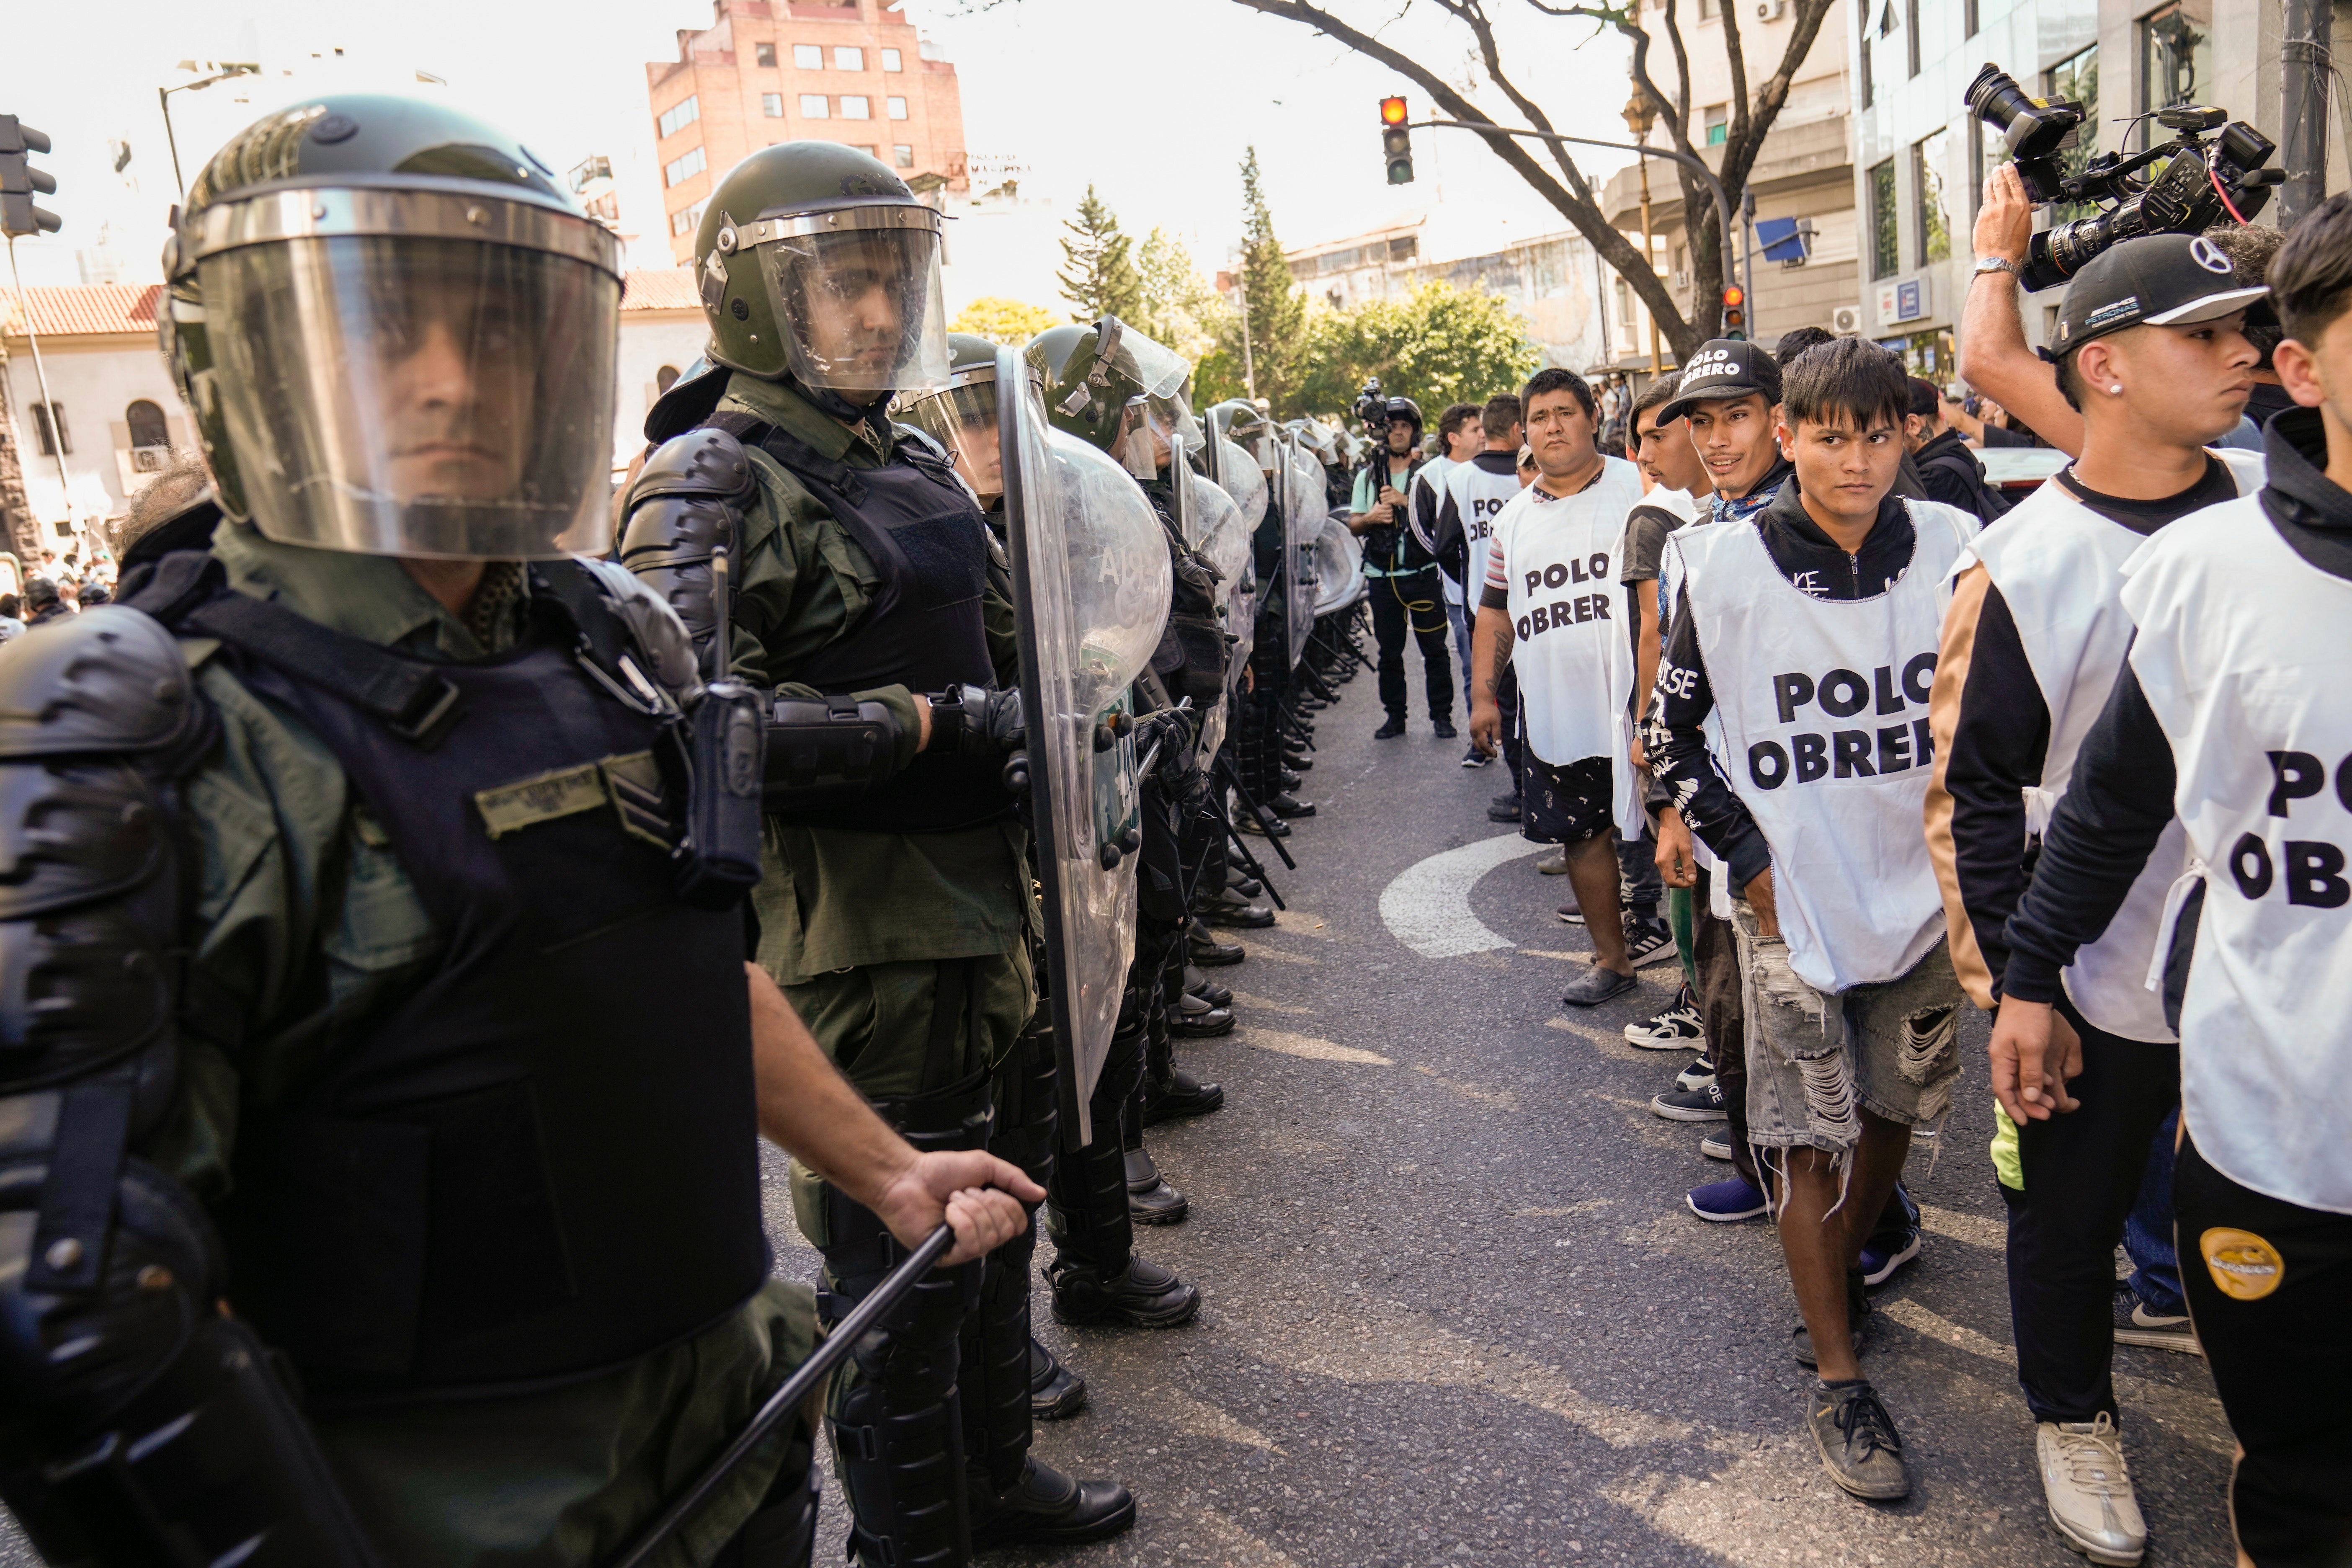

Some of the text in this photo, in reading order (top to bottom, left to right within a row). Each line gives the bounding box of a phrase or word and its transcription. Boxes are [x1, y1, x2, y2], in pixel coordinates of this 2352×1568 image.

[2149, 227, 2166, 235] SONY
[2085, 302, 2139, 325] PETRONAS
[1685, 349, 1728, 374] POLO
[1679, 363, 1740, 393] OBRERO
[1473, 498, 1510, 517] PO
[1525, 552, 1609, 599] POLO
[1773, 652, 1938, 724] POLO
